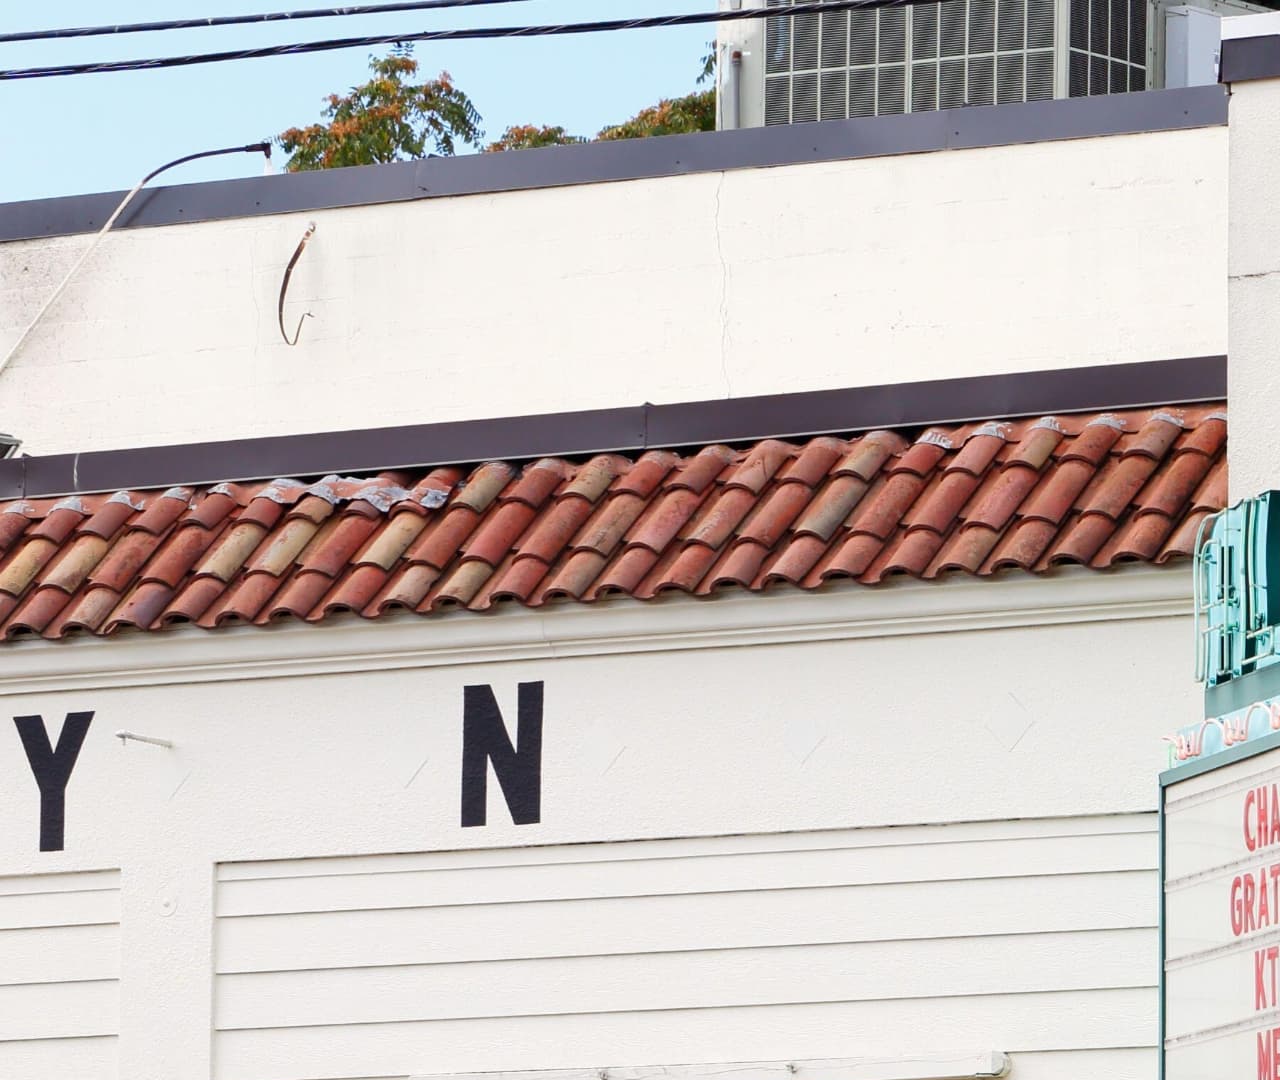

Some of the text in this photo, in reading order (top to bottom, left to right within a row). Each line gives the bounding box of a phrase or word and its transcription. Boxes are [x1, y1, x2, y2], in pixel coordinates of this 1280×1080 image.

[12, 681, 544, 853] Y N
[1254, 945, 1280, 1010] KT
